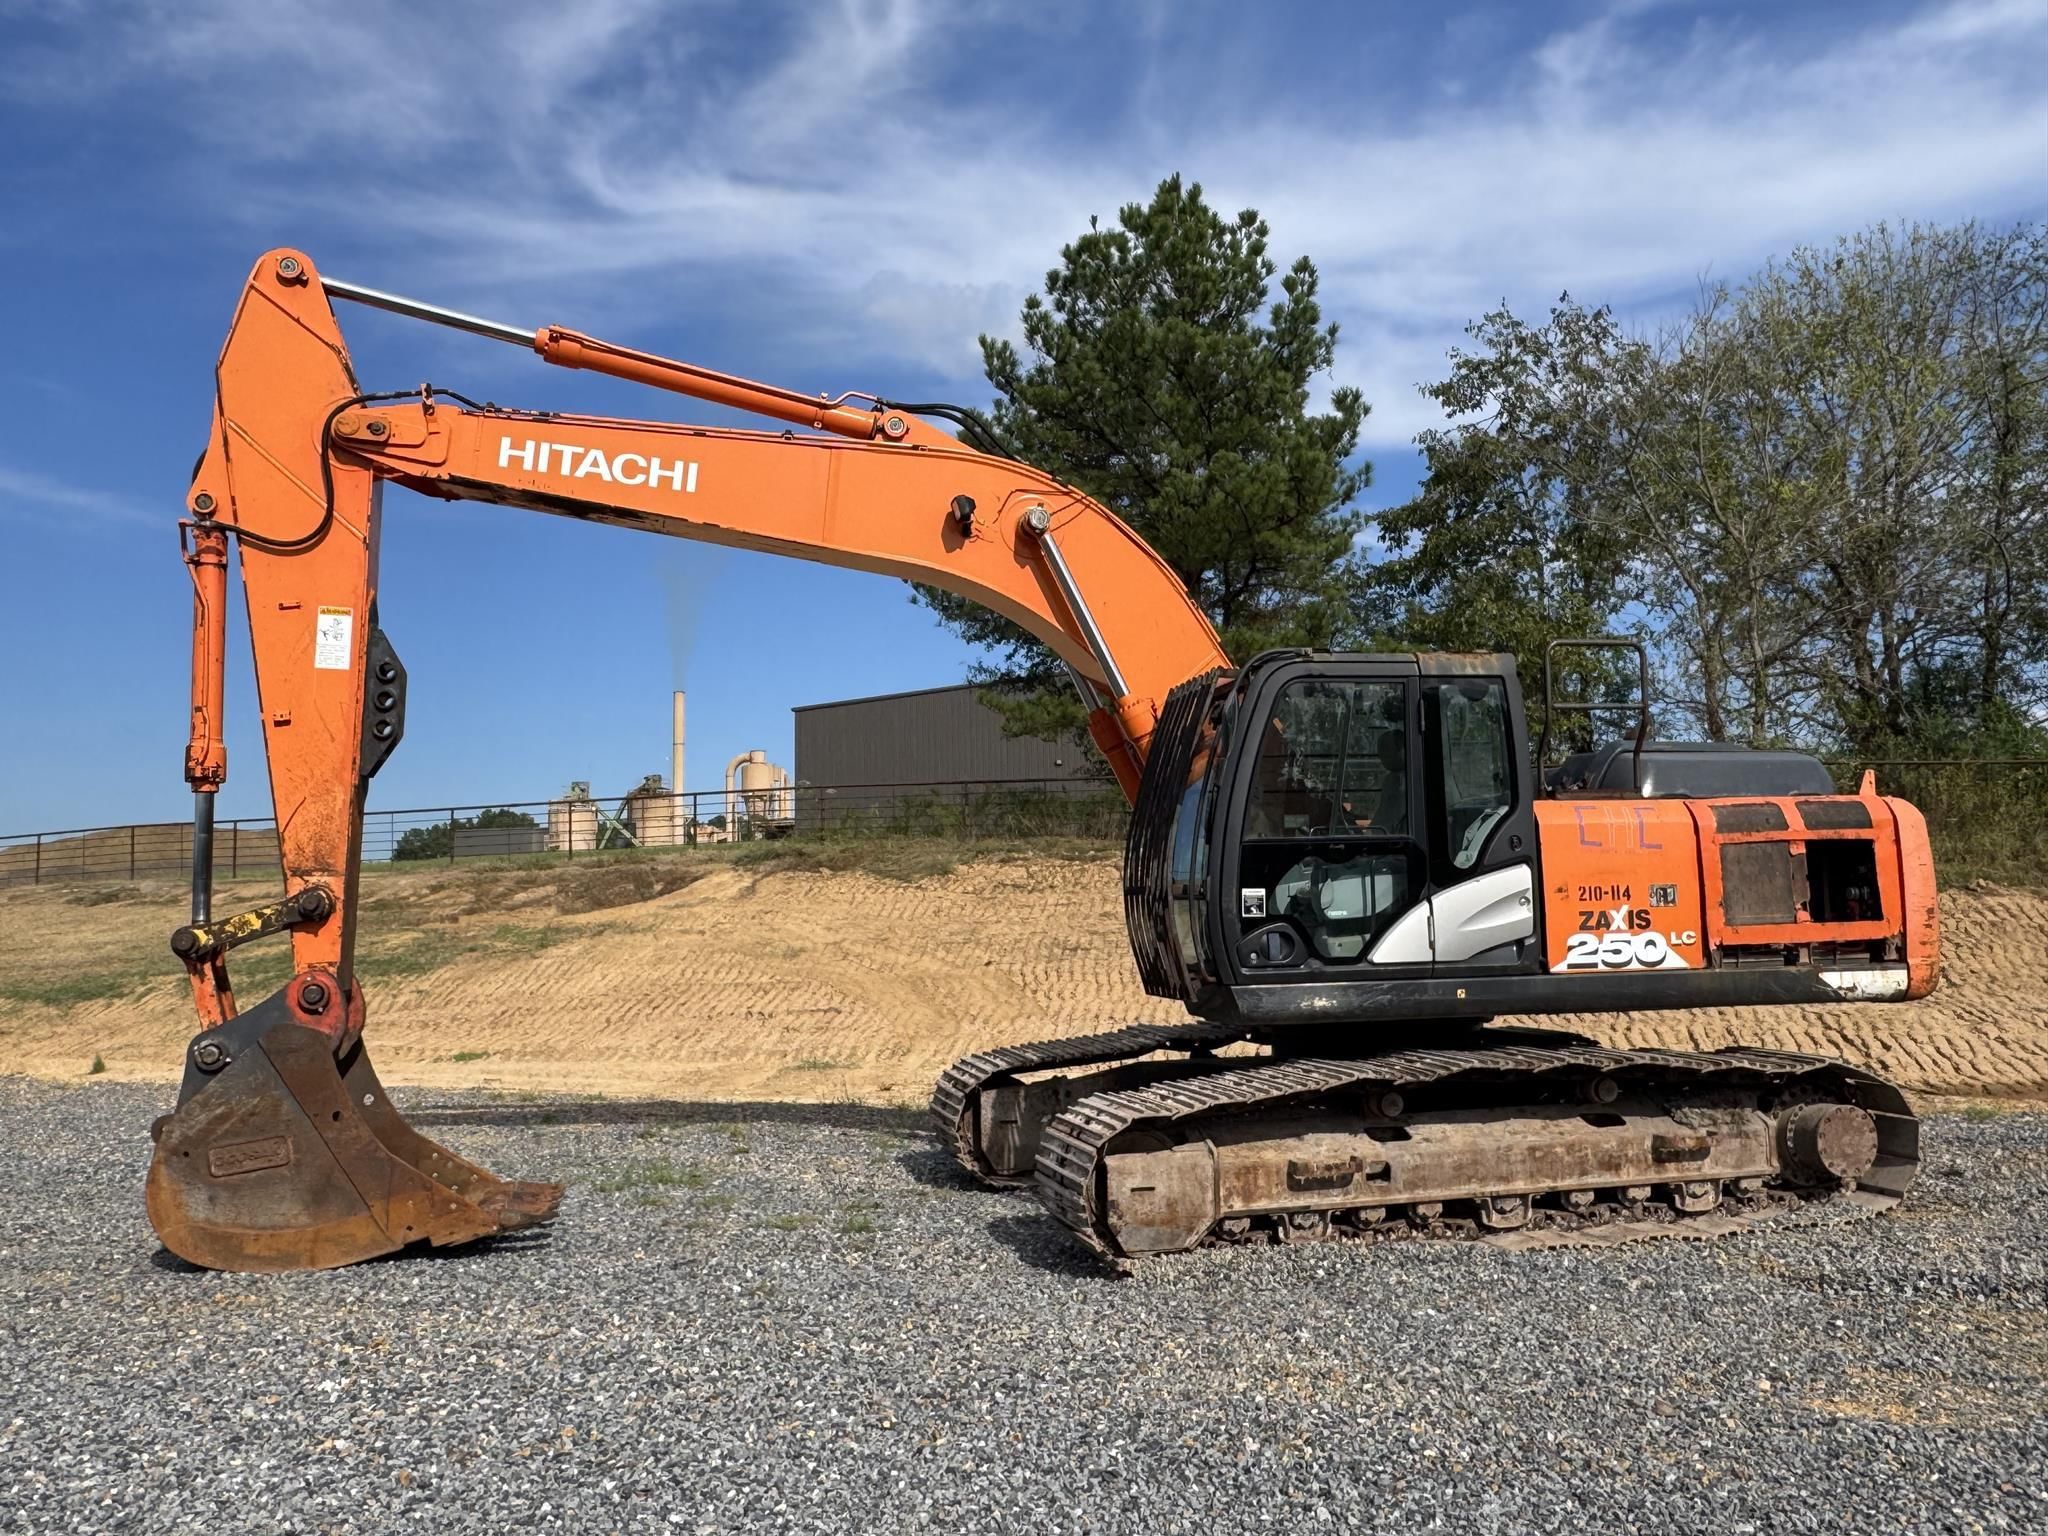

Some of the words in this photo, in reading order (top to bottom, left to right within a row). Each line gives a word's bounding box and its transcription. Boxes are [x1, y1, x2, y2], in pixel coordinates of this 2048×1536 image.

[498, 436, 699, 493] HITACHI
[1578, 885, 1631, 902] 210-114
[1579, 905, 1651, 930] ZAXIS
[1566, 932, 1668, 970] 250
[1671, 931, 1697, 946] LC
